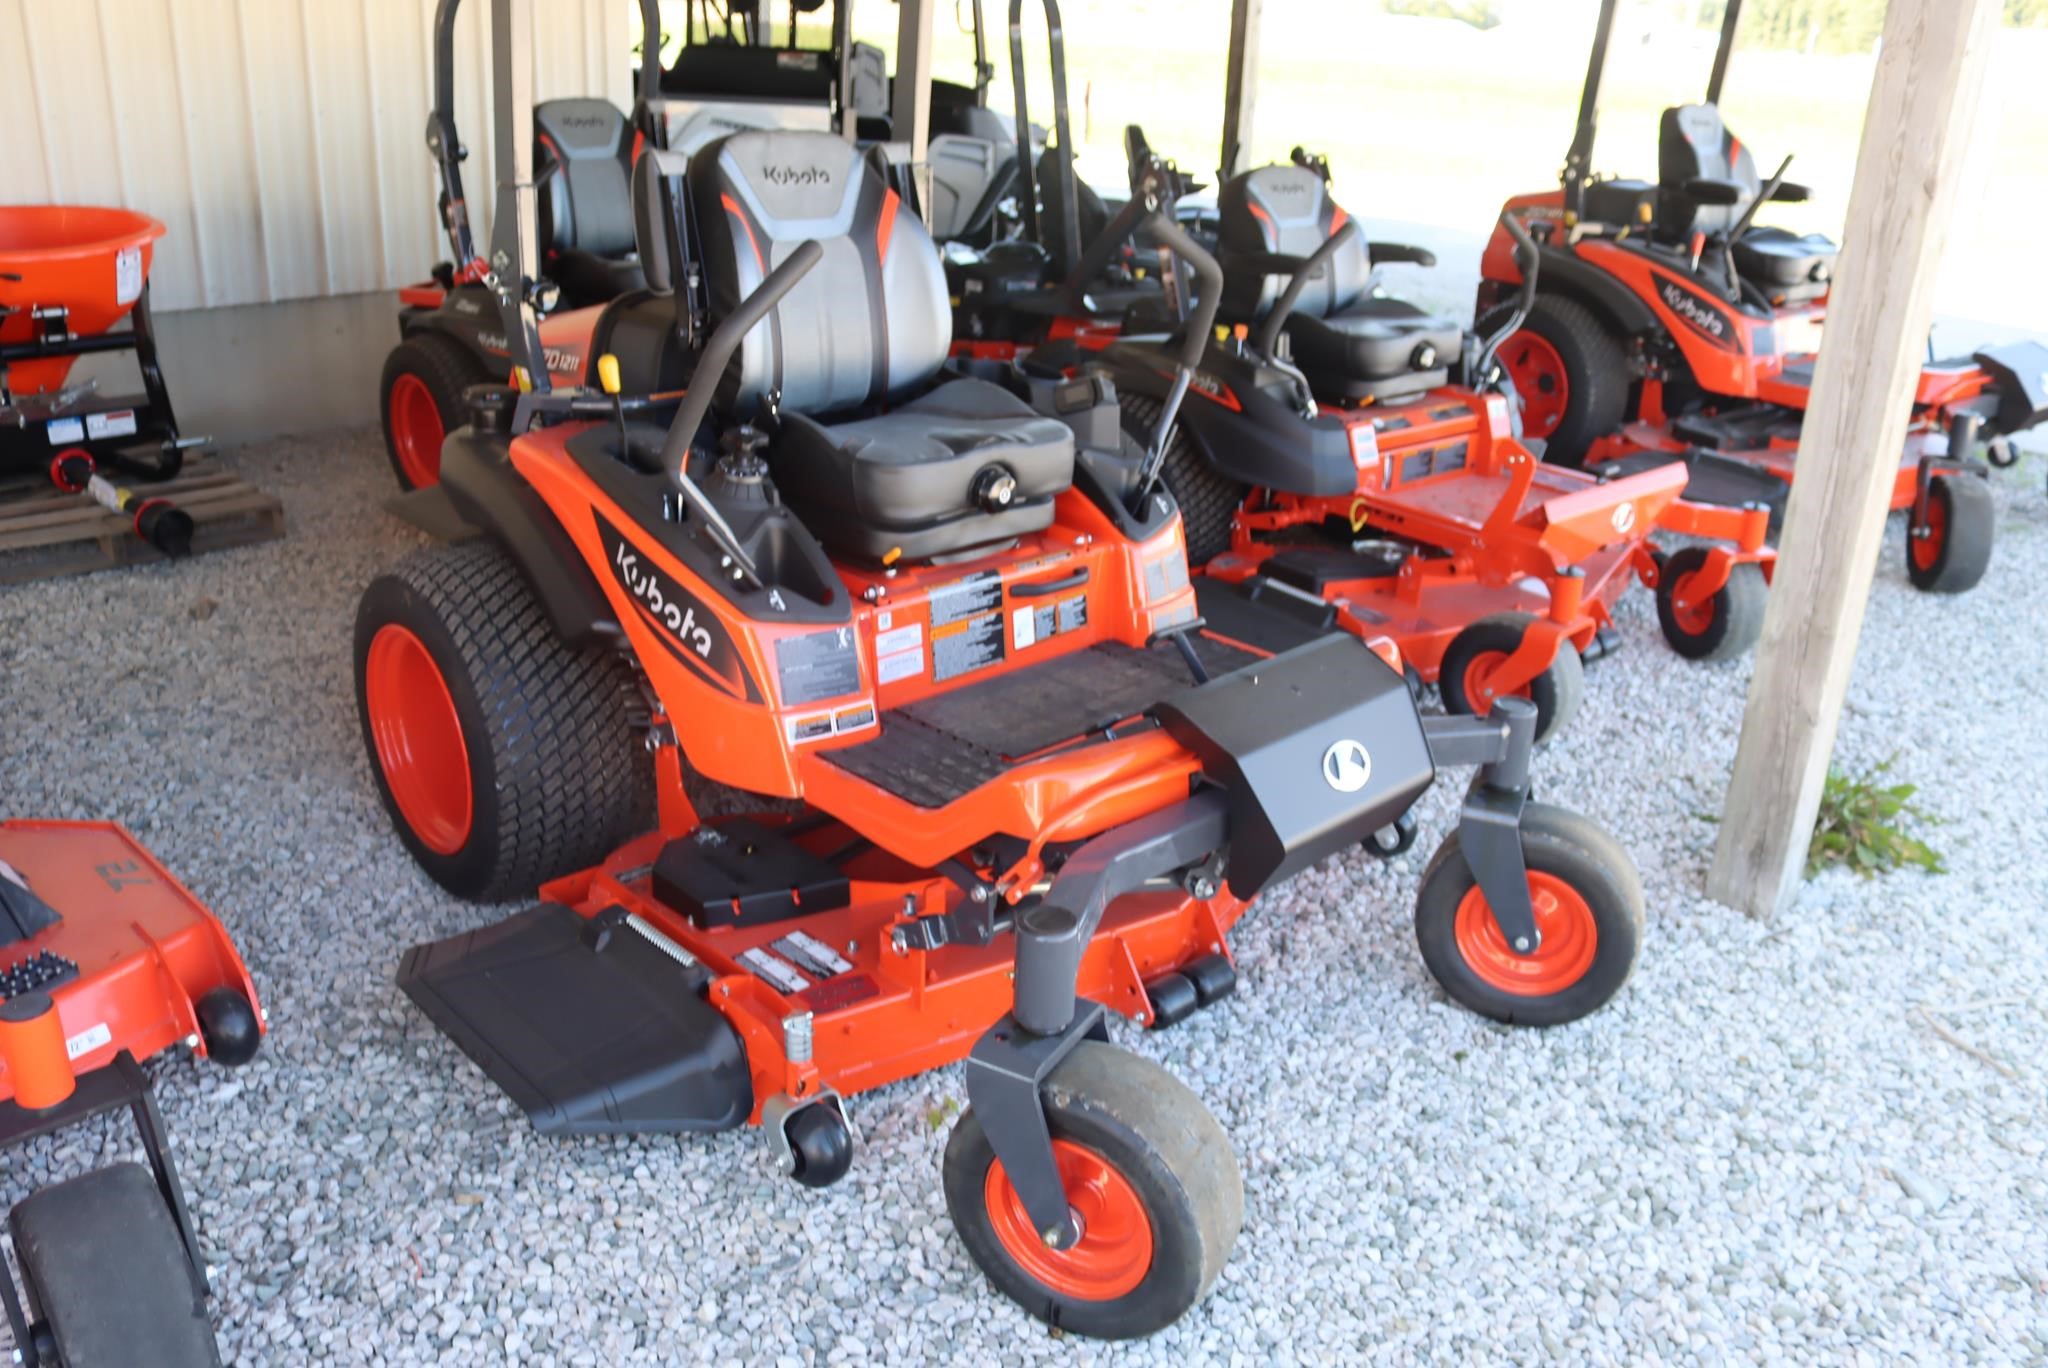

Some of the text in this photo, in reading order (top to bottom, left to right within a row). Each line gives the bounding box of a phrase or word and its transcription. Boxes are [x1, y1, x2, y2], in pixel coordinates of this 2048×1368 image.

[763, 165, 830, 185] Kubota
[1664, 283, 1724, 336] Kubota
[616, 541, 712, 658] Kubota
